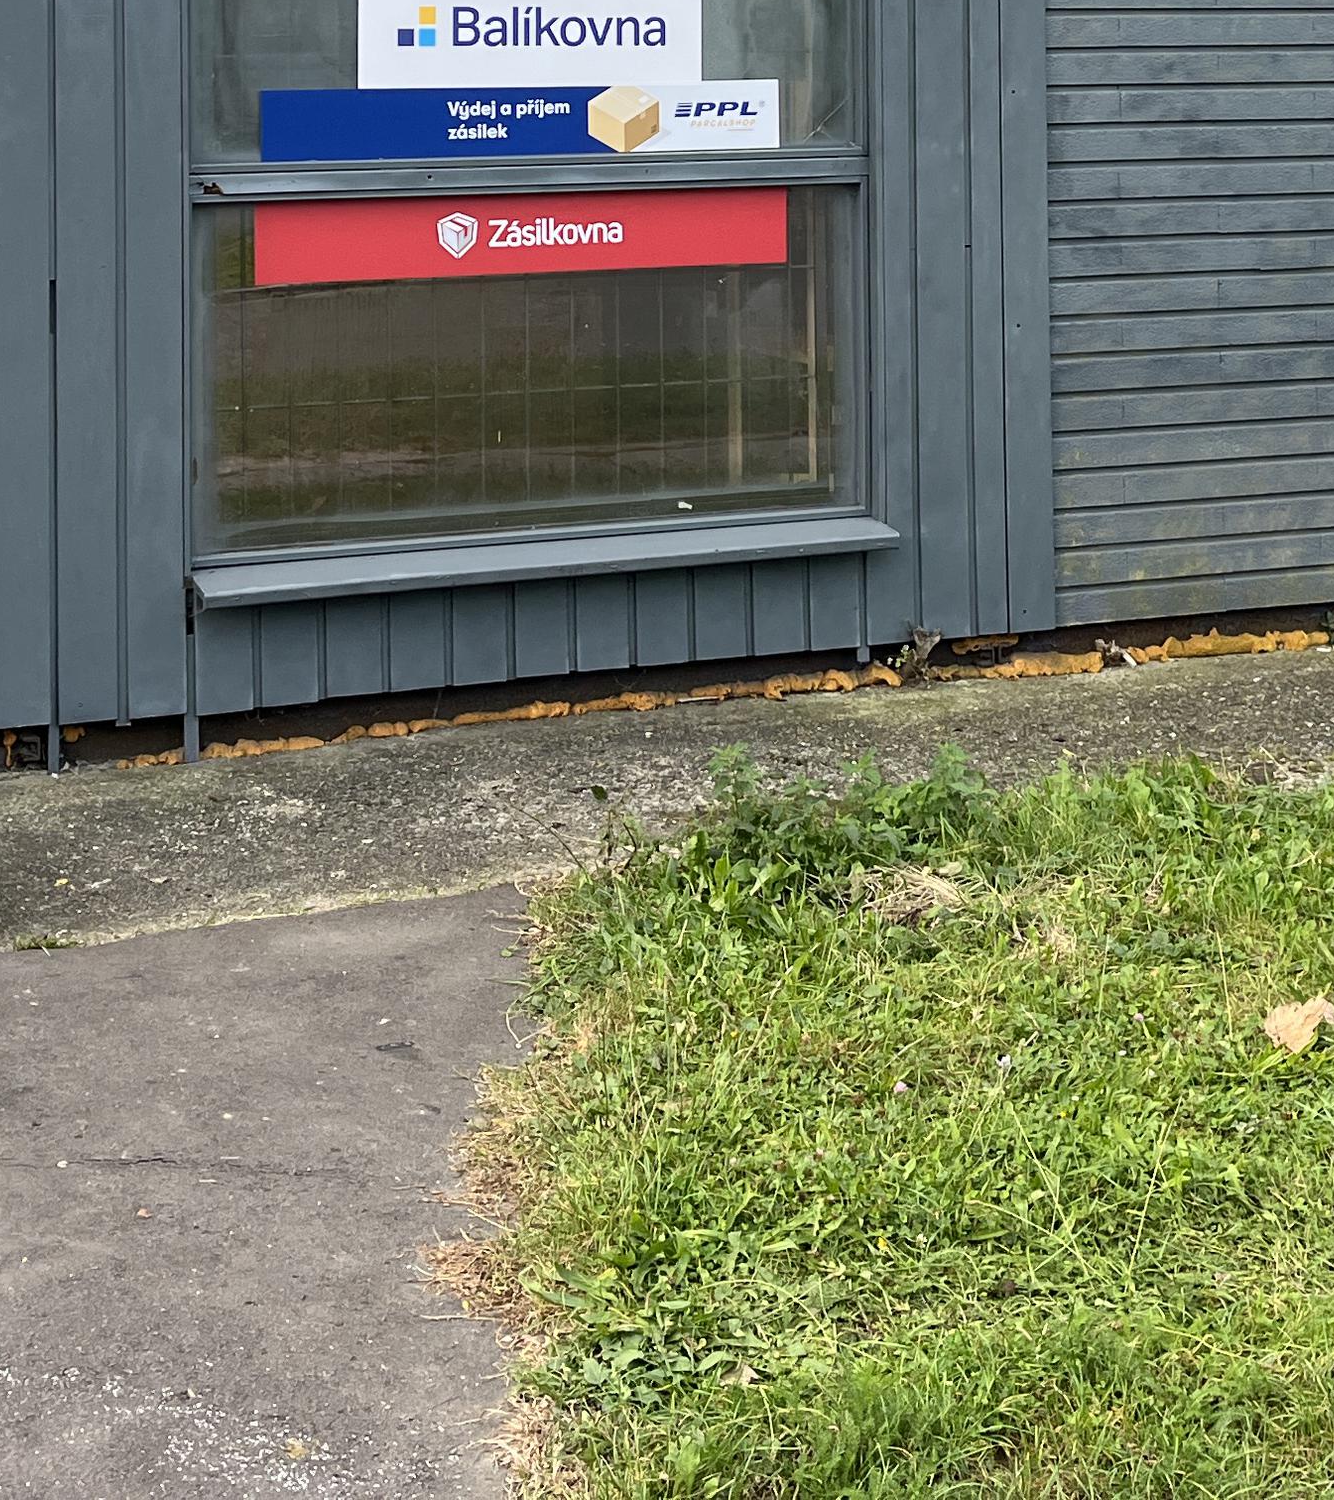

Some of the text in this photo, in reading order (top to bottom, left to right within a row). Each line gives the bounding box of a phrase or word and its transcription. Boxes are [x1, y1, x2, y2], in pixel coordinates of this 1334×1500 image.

[452, 6, 667, 47] Balíkovna
[447, 99, 571, 120] Výdej a příjem
[693, 101, 758, 117] PPL
[447, 123, 508, 140] zásilek
[488, 217, 624, 248] Zásilkovna
